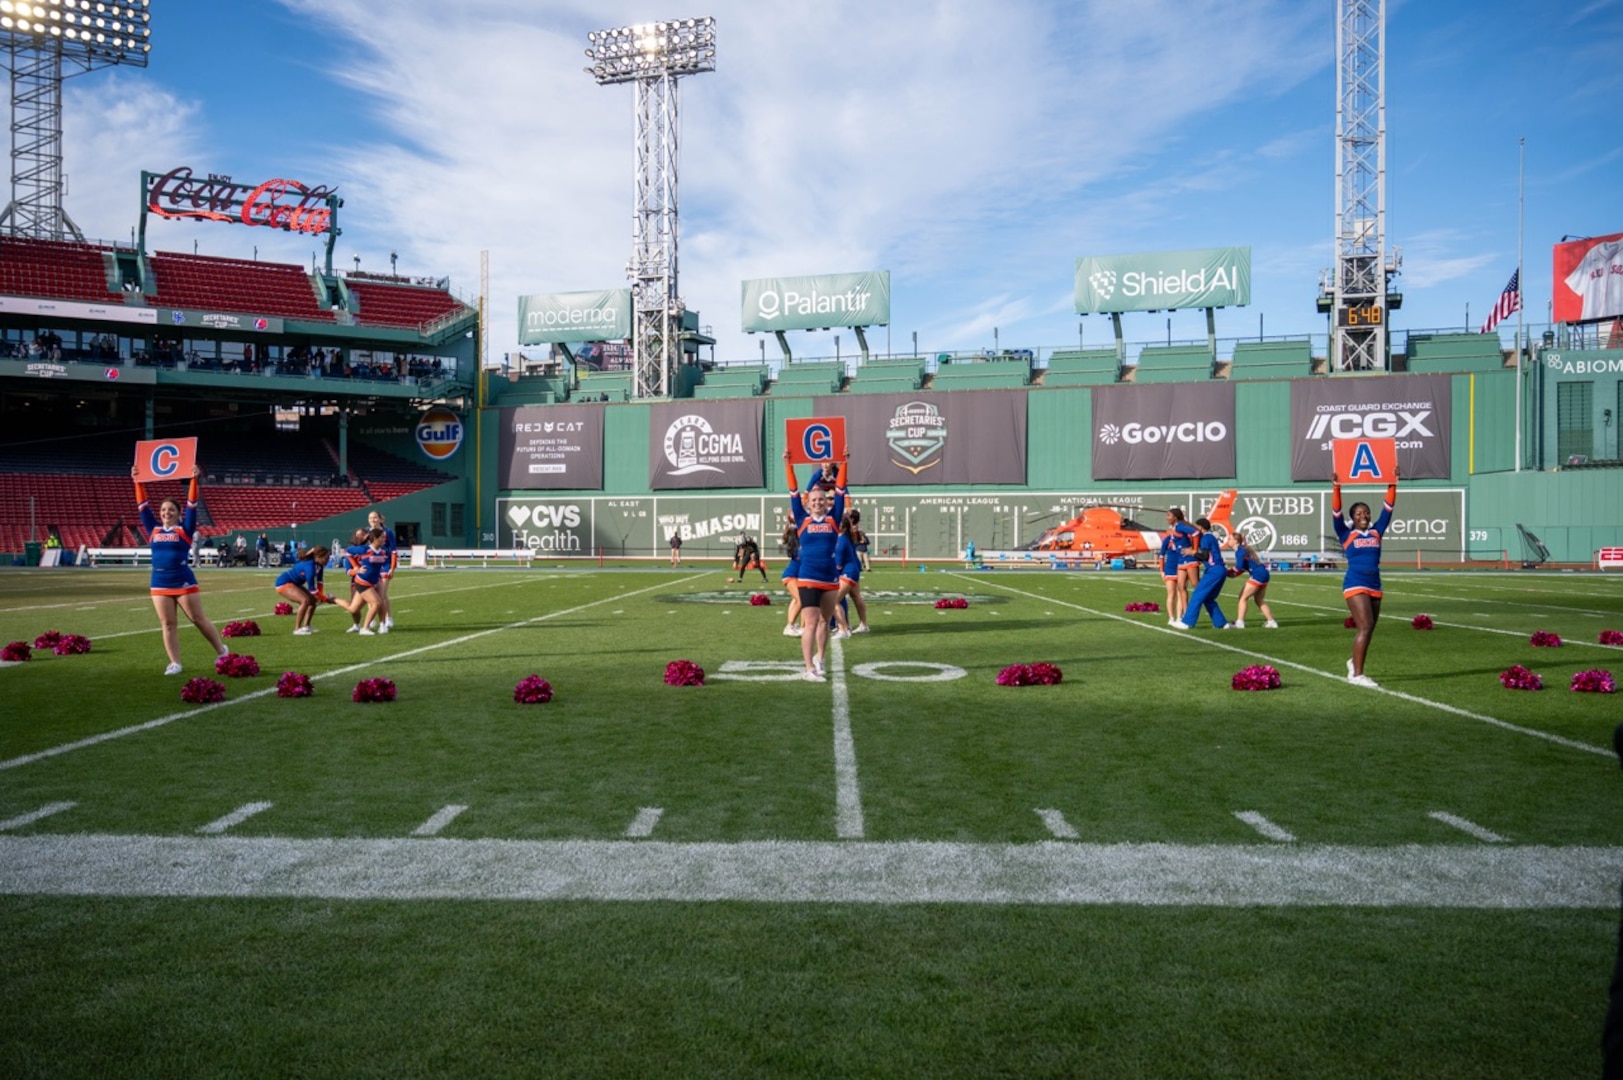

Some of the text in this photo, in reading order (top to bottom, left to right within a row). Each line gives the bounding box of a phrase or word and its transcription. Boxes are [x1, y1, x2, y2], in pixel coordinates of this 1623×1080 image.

[1122, 265, 1237, 297] Shield AI
[784, 286, 871, 316] Palantir
[528, 306, 616, 327] moderna
[1348, 305, 1381, 325] 6:48
[1317, 401, 1432, 412] COAST GUARD EXCHANGE
[418, 425, 460, 441] Gulf
[556, 422, 584, 432] CAT
[907, 427, 926, 438] CUP
[1122, 421, 1227, 444] GovCIO
[698, 434, 743, 455] CGMA
[803, 423, 833, 461] G
[151, 444, 180, 477] C
[1349, 442, 1382, 478] A
[531, 505, 581, 528] CVS
[1243, 497, 1315, 515] WEBB
[482, 533, 494, 542] 310
[511, 530, 582, 551] Health
[1281, 534, 1309, 546] 1866
[1469, 531, 1488, 541] 379
